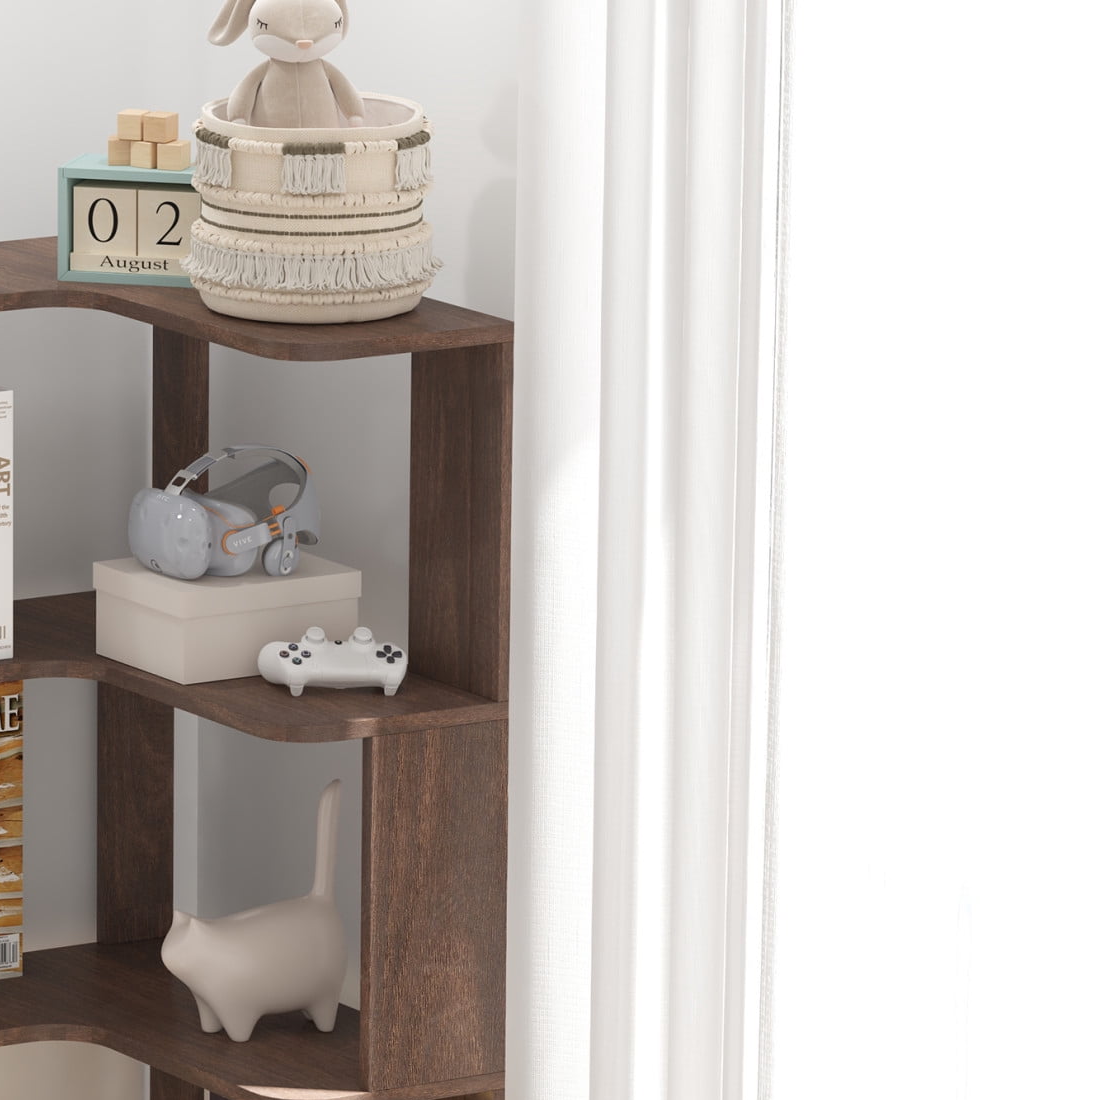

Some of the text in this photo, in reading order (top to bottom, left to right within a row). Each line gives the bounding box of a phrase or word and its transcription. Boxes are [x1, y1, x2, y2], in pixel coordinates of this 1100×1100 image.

[88, 198, 182, 246] 0 2
[100, 255, 169, 272] August
[233, 536, 252, 547] VIVE
